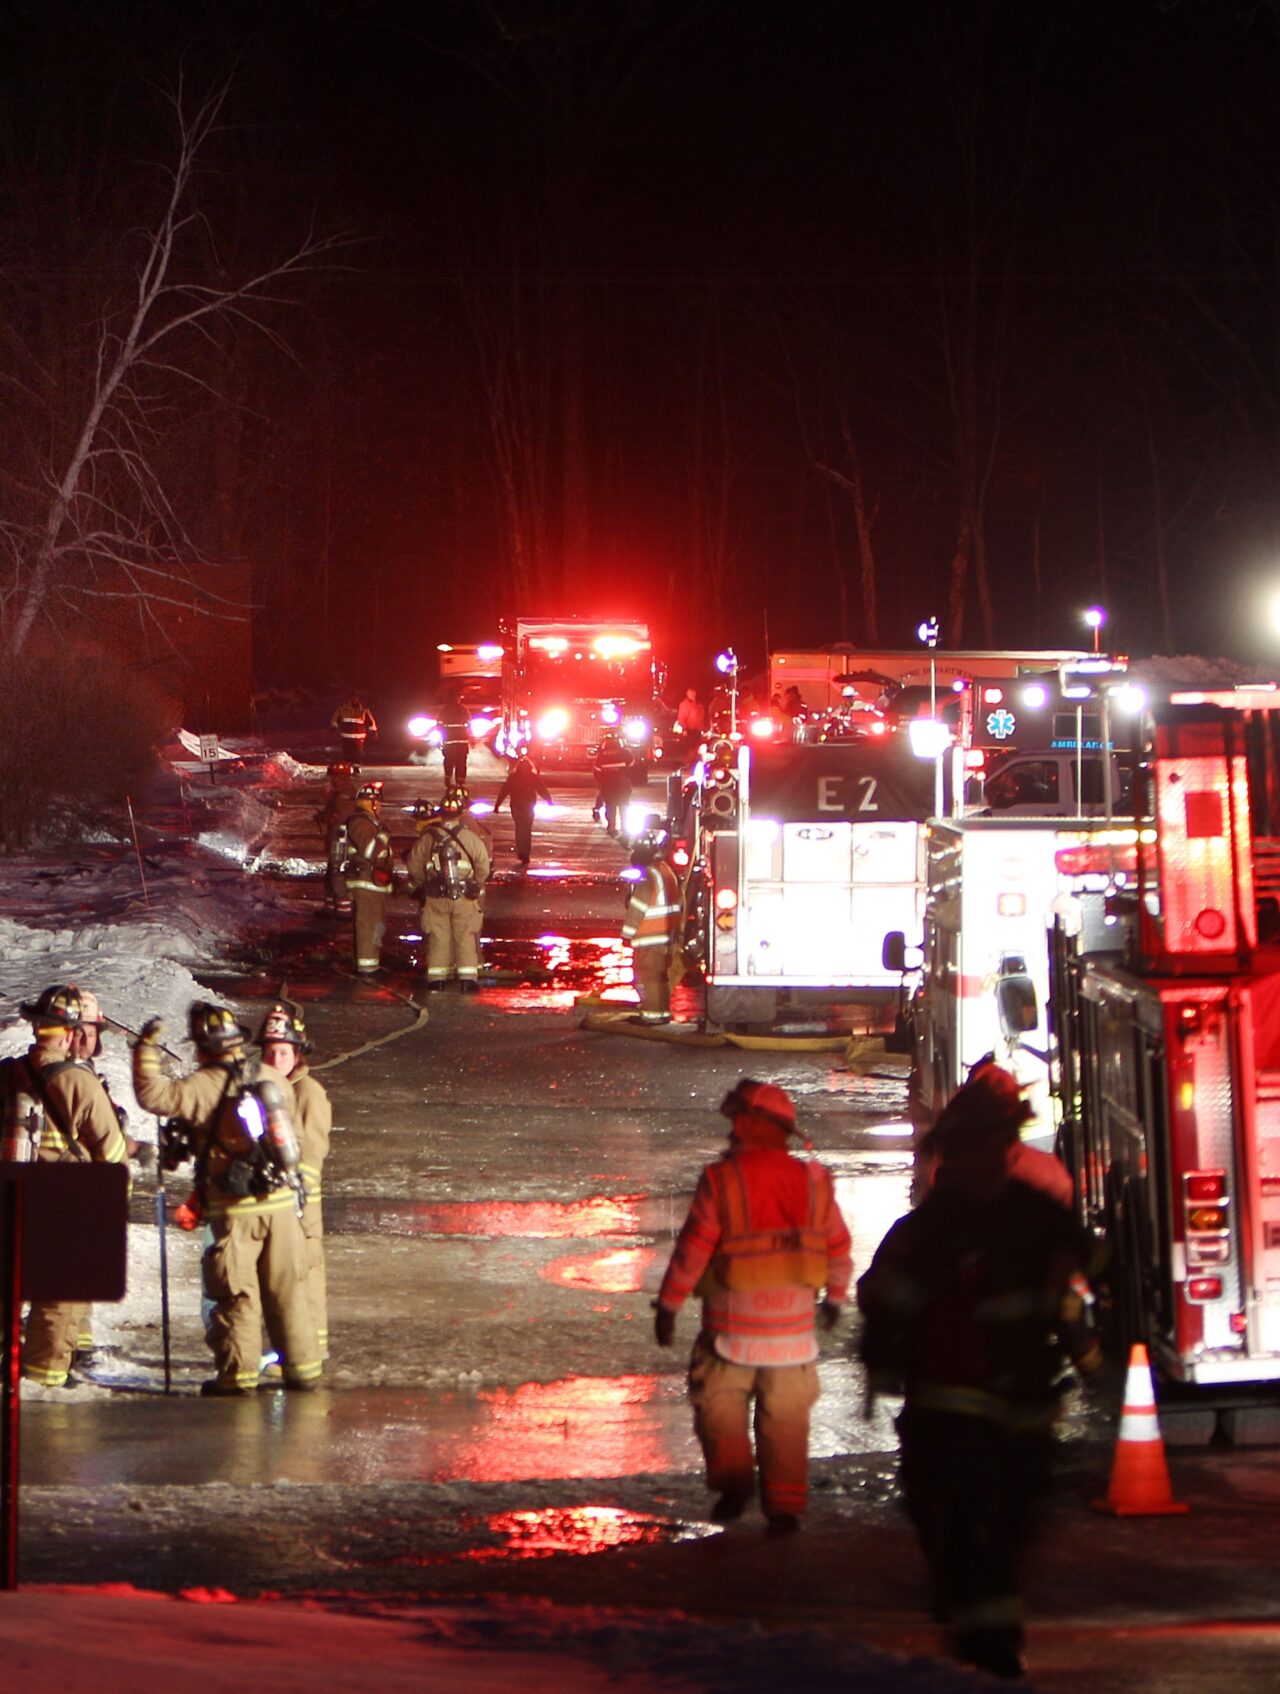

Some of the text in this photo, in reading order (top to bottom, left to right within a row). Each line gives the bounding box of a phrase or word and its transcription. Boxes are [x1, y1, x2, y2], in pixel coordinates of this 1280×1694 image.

[203, 748, 216, 758] 15
[818, 776, 878, 811] E 2
